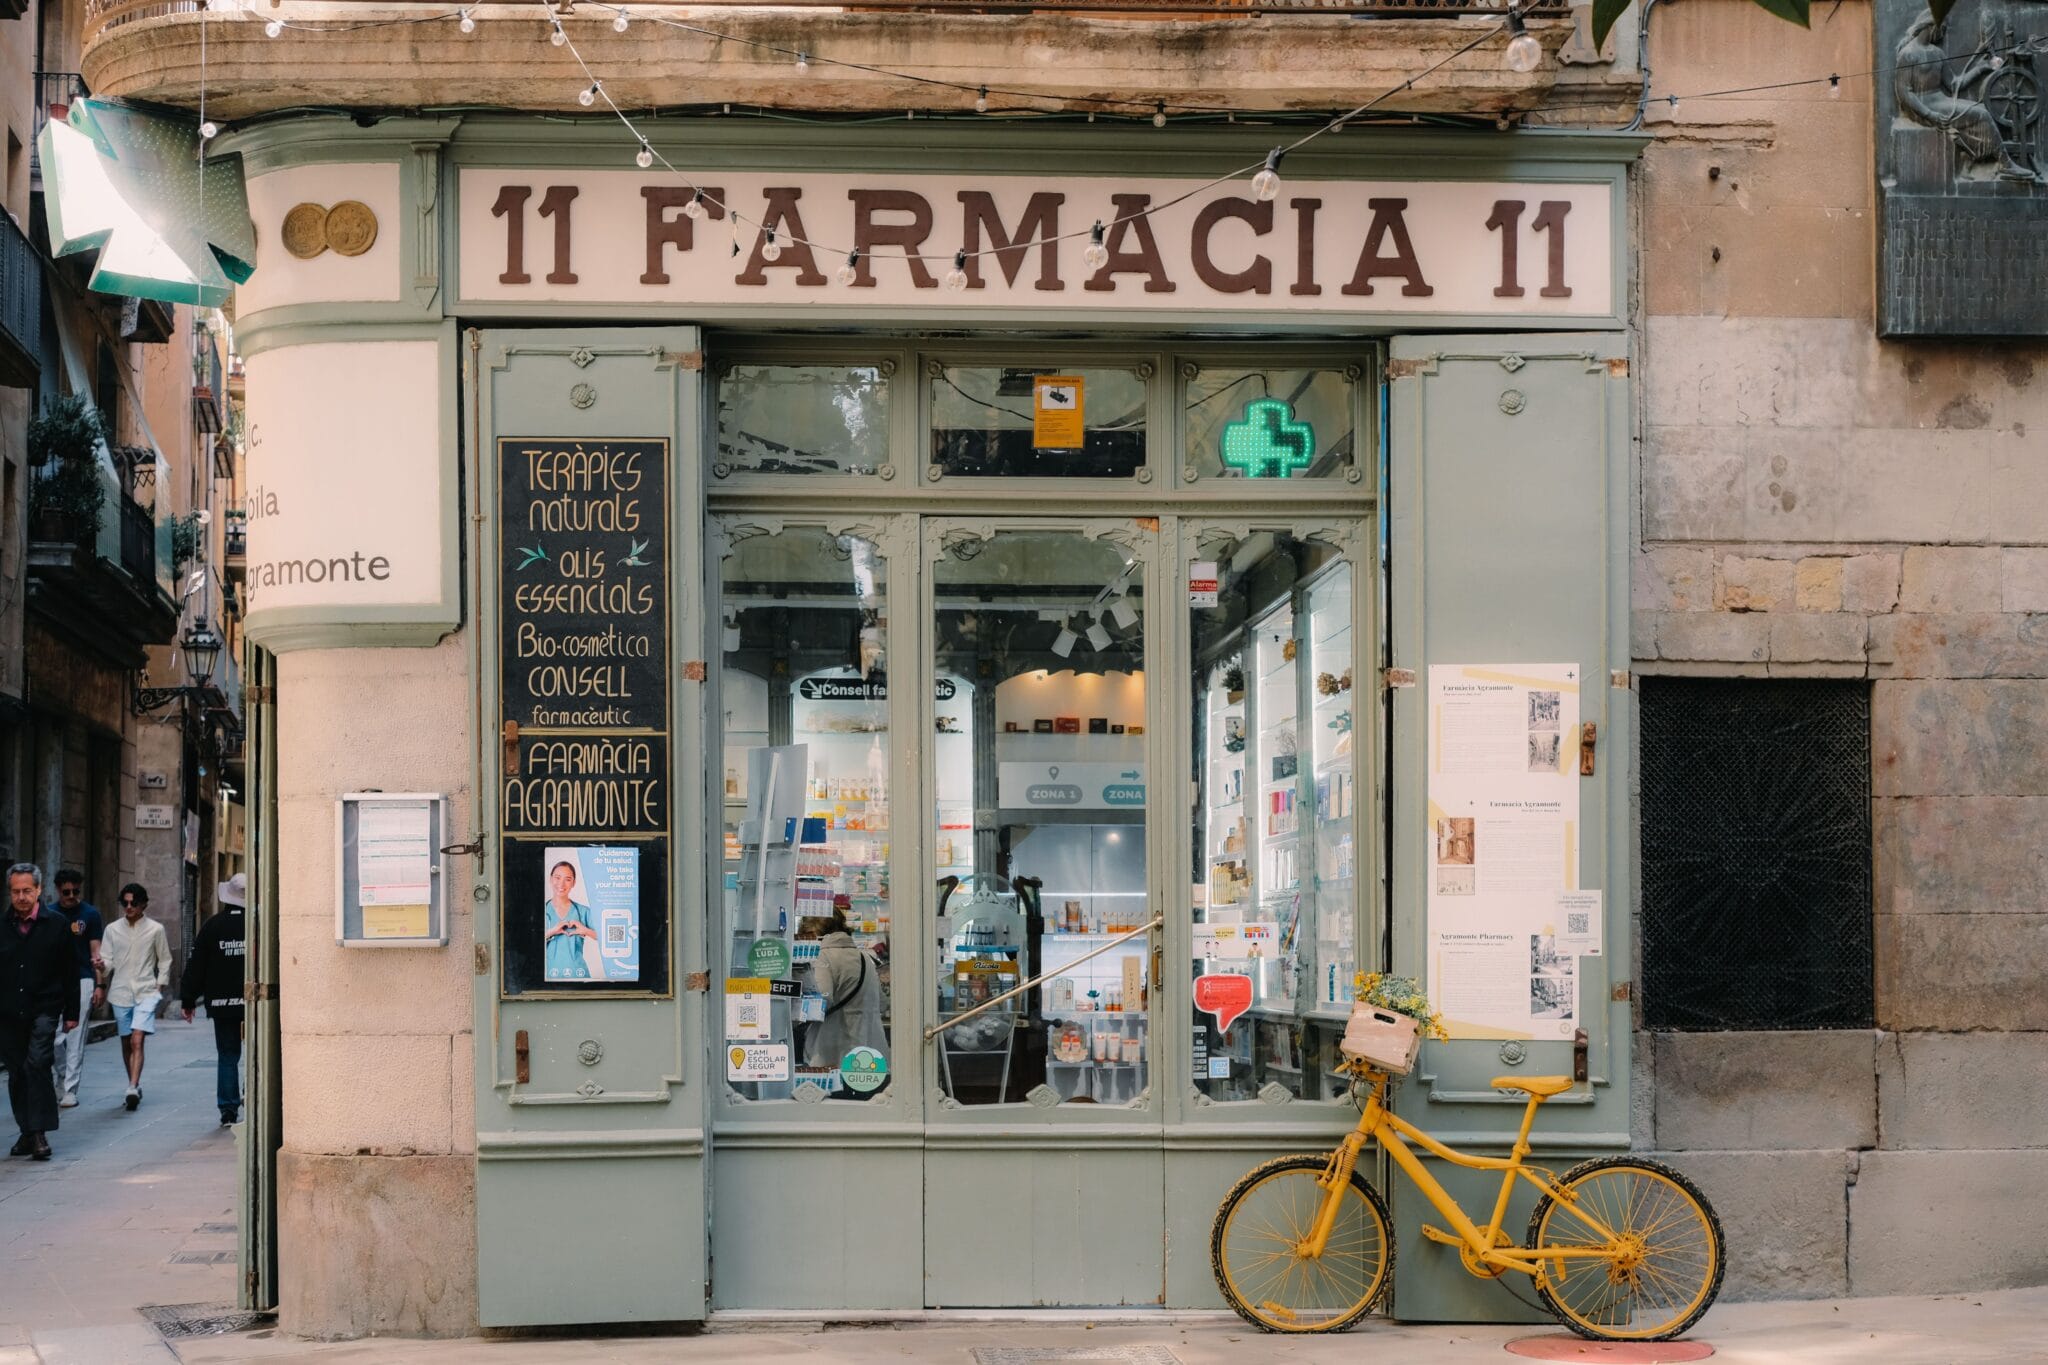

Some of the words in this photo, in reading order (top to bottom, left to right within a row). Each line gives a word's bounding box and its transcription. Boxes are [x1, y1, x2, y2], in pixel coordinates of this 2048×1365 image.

[491, 185, 579, 285] 11
[640, 185, 1434, 297] FARMACIA
[1485, 199, 1573, 298] 11
[246, 484, 281, 521] oila
[529, 492, 640, 532] naturals
[247, 551, 391, 603] gramonte
[1190, 581, 1217, 589] Alarma
[517, 621, 649, 658] Bio-cosmètica
[528, 665, 632, 698] CONSELL
[822, 683, 871, 696] Consell
[531, 704, 631, 725] farmacèutic
[505, 778, 659, 827] AGRAMONTE
[1032, 790, 1065, 799] ZONA
[1069, 790, 1076, 799] 1
[1108, 790, 1142, 799] ZONA
[756, 949, 780, 958] LUDA
[770, 983, 794, 993] ERT
[211, 998, 228, 1007] NEW
[847, 1074, 880, 1083] GIURA
